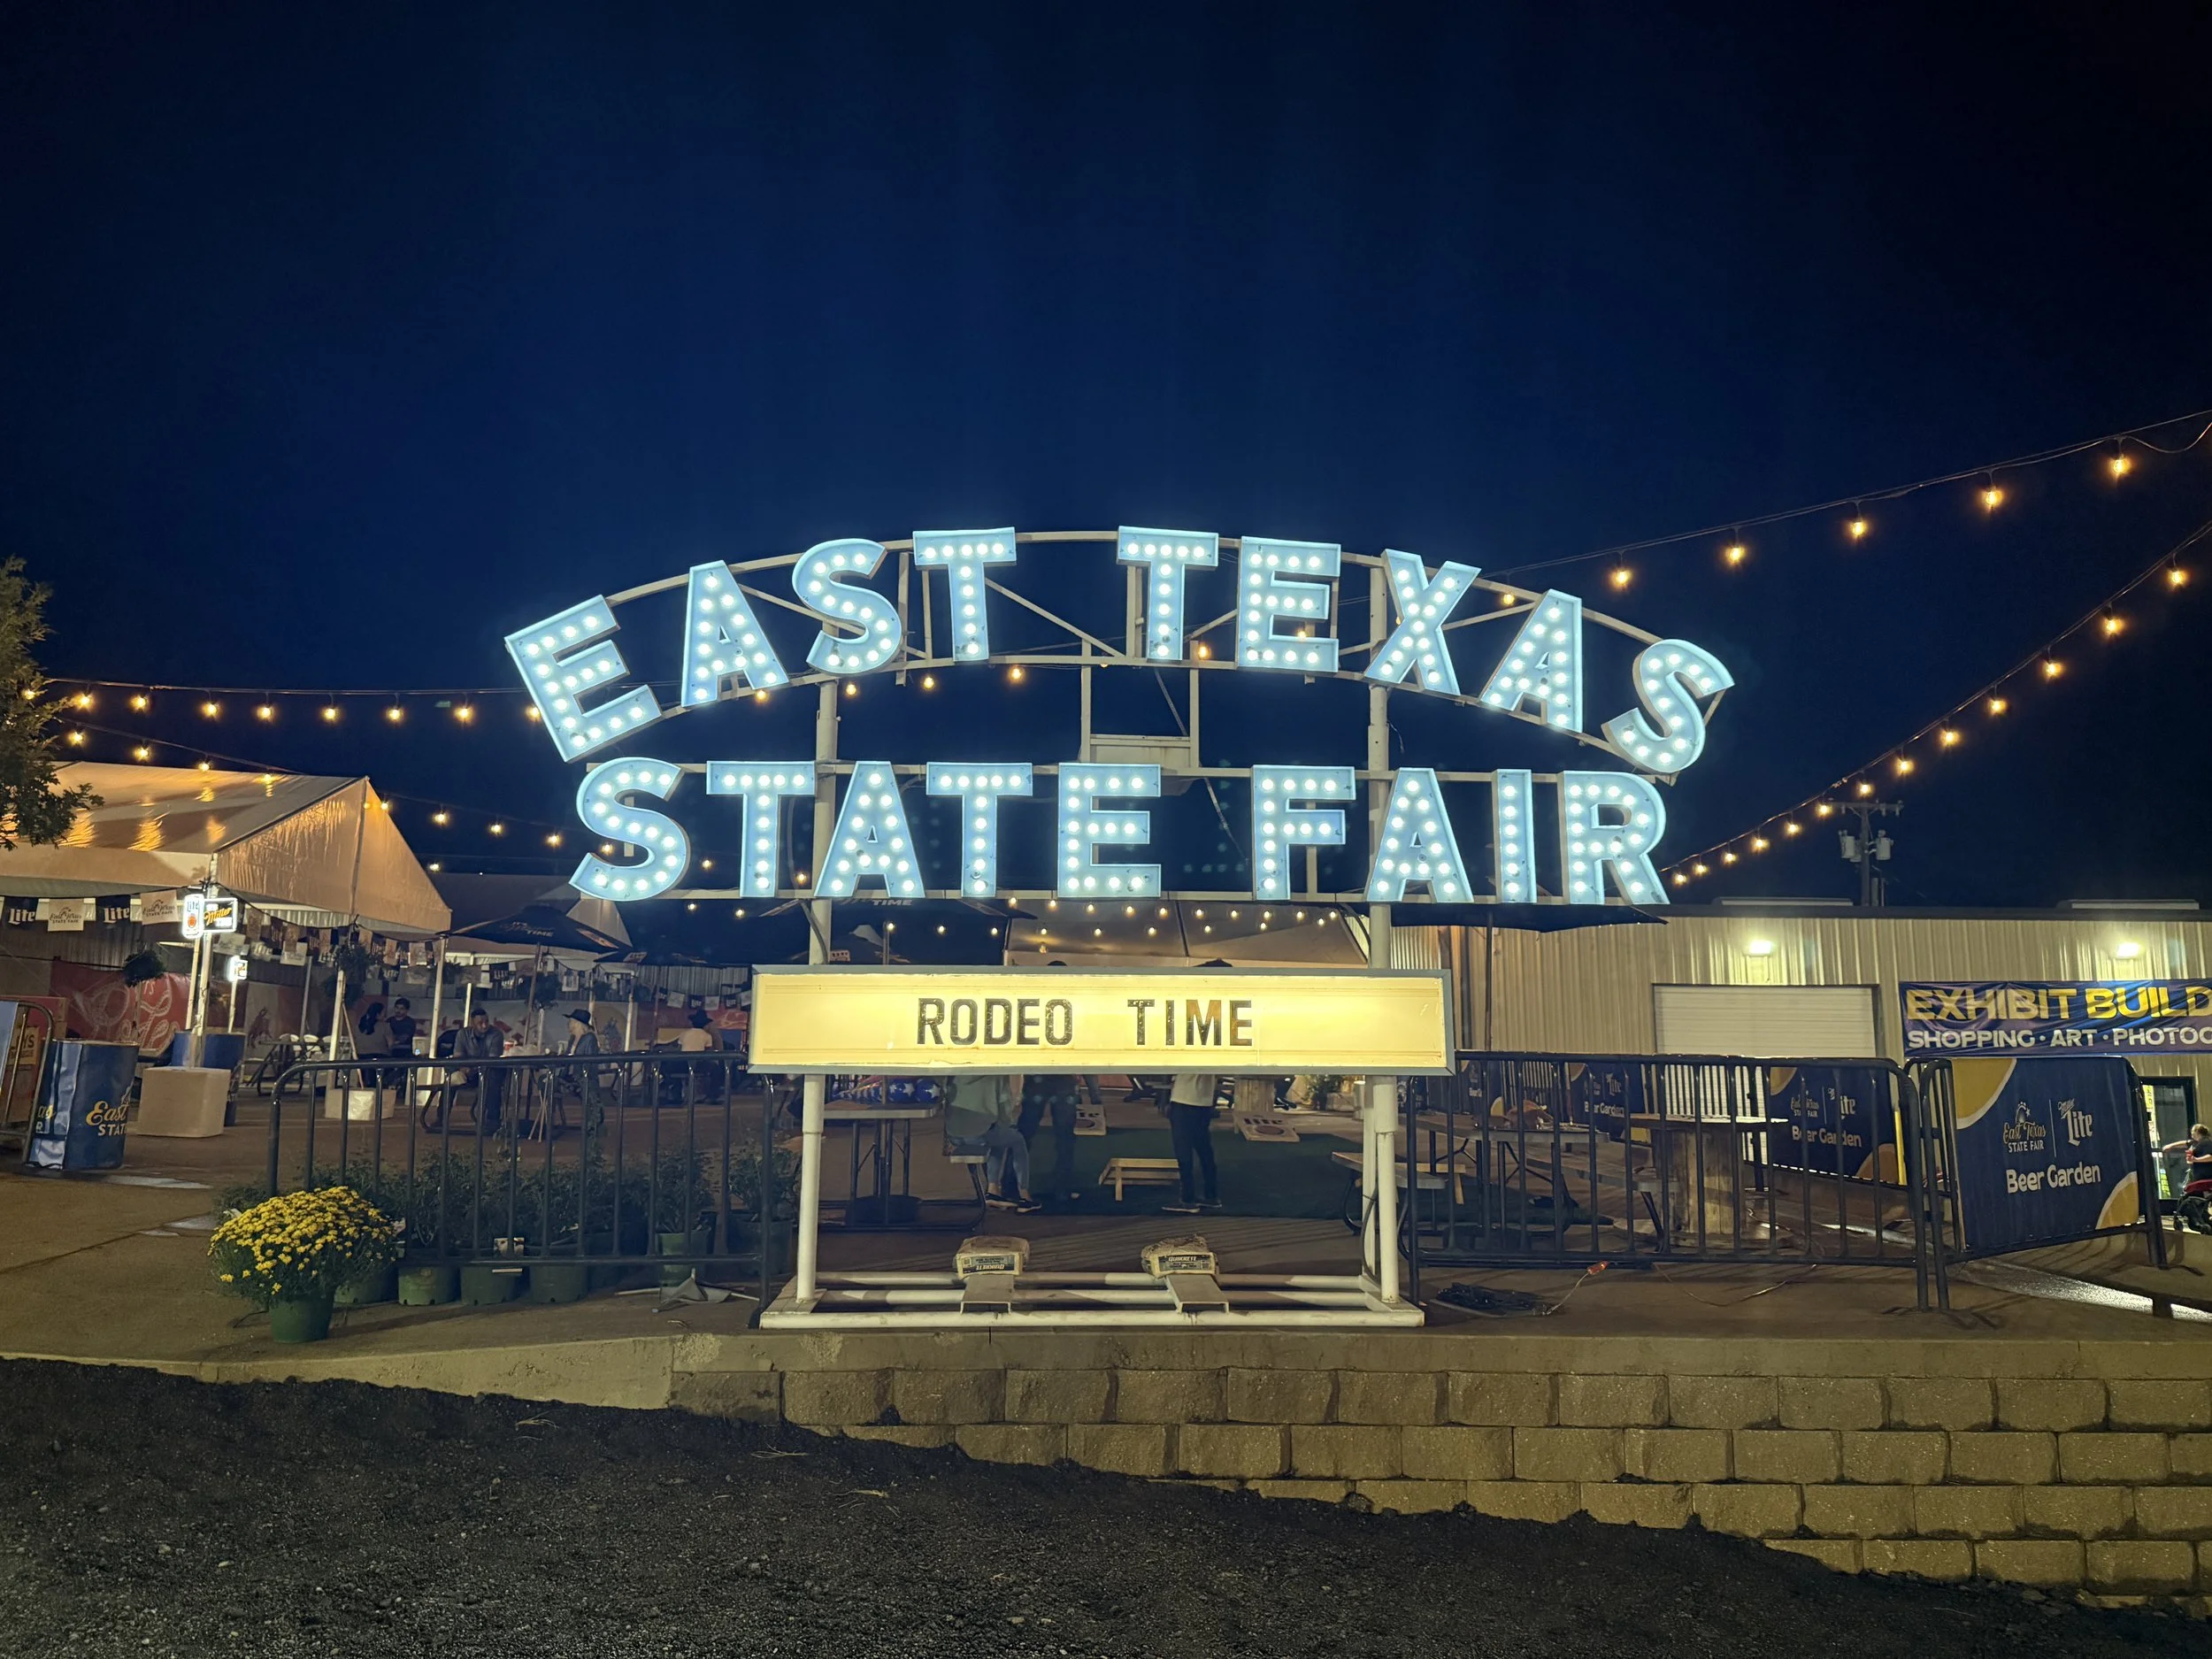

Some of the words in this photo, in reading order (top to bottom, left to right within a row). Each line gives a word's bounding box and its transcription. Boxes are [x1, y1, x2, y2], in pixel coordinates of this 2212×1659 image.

[504, 526, 1016, 763] EAST
[1116, 526, 1735, 772] TEXAS
[568, 757, 1161, 901] STATE
[1251, 764, 1671, 904] FAIR
[8, 908, 36, 926] Lite
[104, 907, 130, 925] Lite
[204, 907, 232, 926] Miller
[1905, 987, 2078, 1020] EXHIBIT
[2085, 986, 2212, 1018] BUILD
[917, 998, 1073, 1045] RODEO
[1127, 999, 1253, 1046] TIME
[1908, 1029, 2035, 1048] SHOPPING
[2050, 1028, 2098, 1048] ART
[86, 1101, 129, 1125] East
[2002, 1122, 2024, 1144] East
[2023, 1120, 2047, 1141] Texas
[2062, 1108, 2093, 1147] Lite
[2008, 1141, 2028, 1153] STATE
[2030, 1140, 2045, 1151] FAIR
[2006, 1169, 2045, 1194] Beer
[2047, 1161, 2101, 1188] Garden
